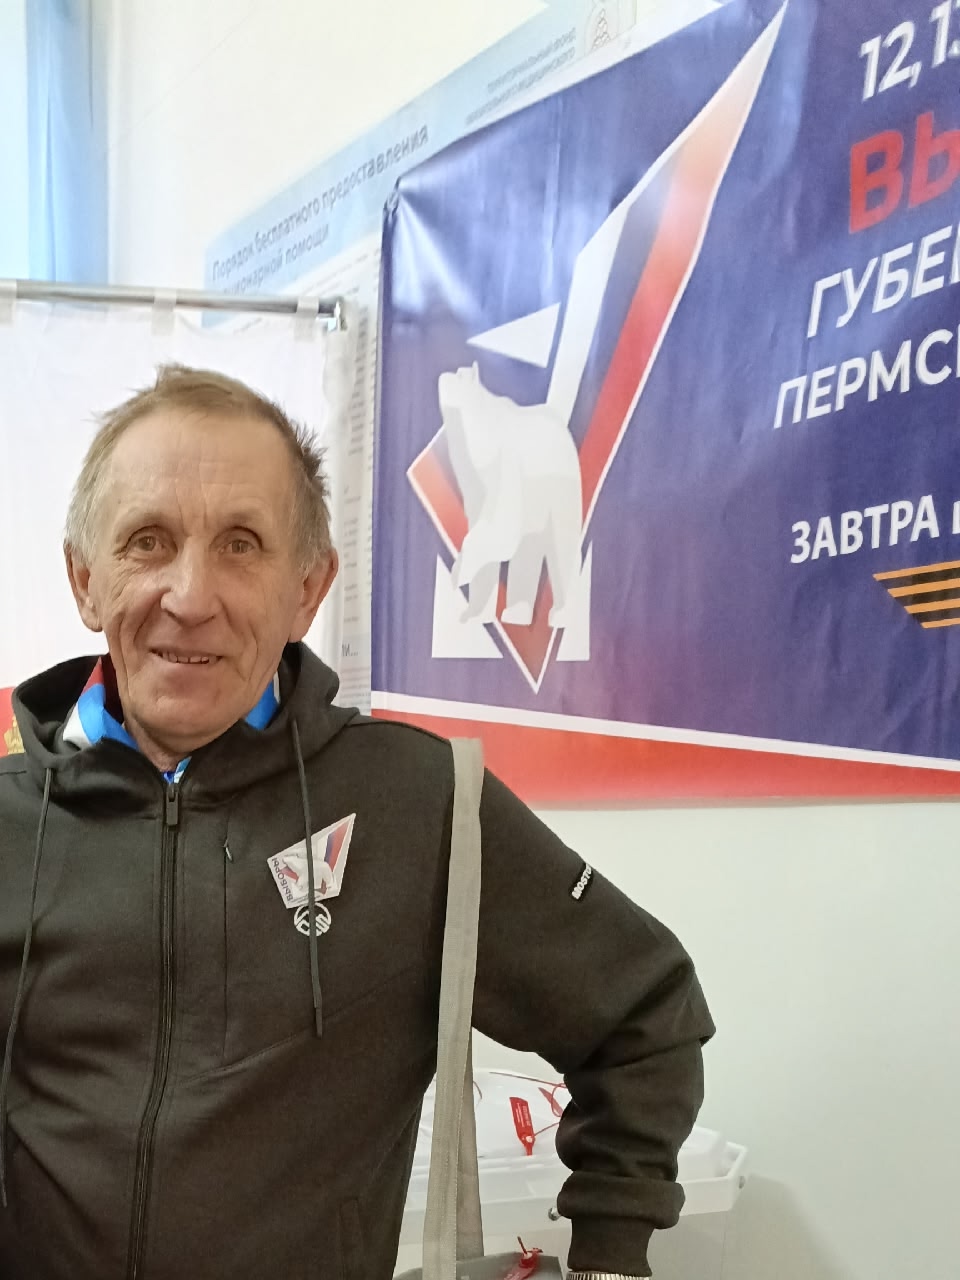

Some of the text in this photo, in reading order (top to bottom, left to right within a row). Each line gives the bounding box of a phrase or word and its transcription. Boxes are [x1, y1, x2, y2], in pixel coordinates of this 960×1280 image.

[254, 197, 320, 252] бесплатного
[322, 124, 429, 212] предоставления
[285, 223, 329, 264] помощи
[807, 221, 960, 338] ГУБЕ
[774, 324, 960, 429] ПЕРМС
[790, 494, 940, 564] ЗАВТРА
[271, 857, 294, 902] ВЫБОРЫ
